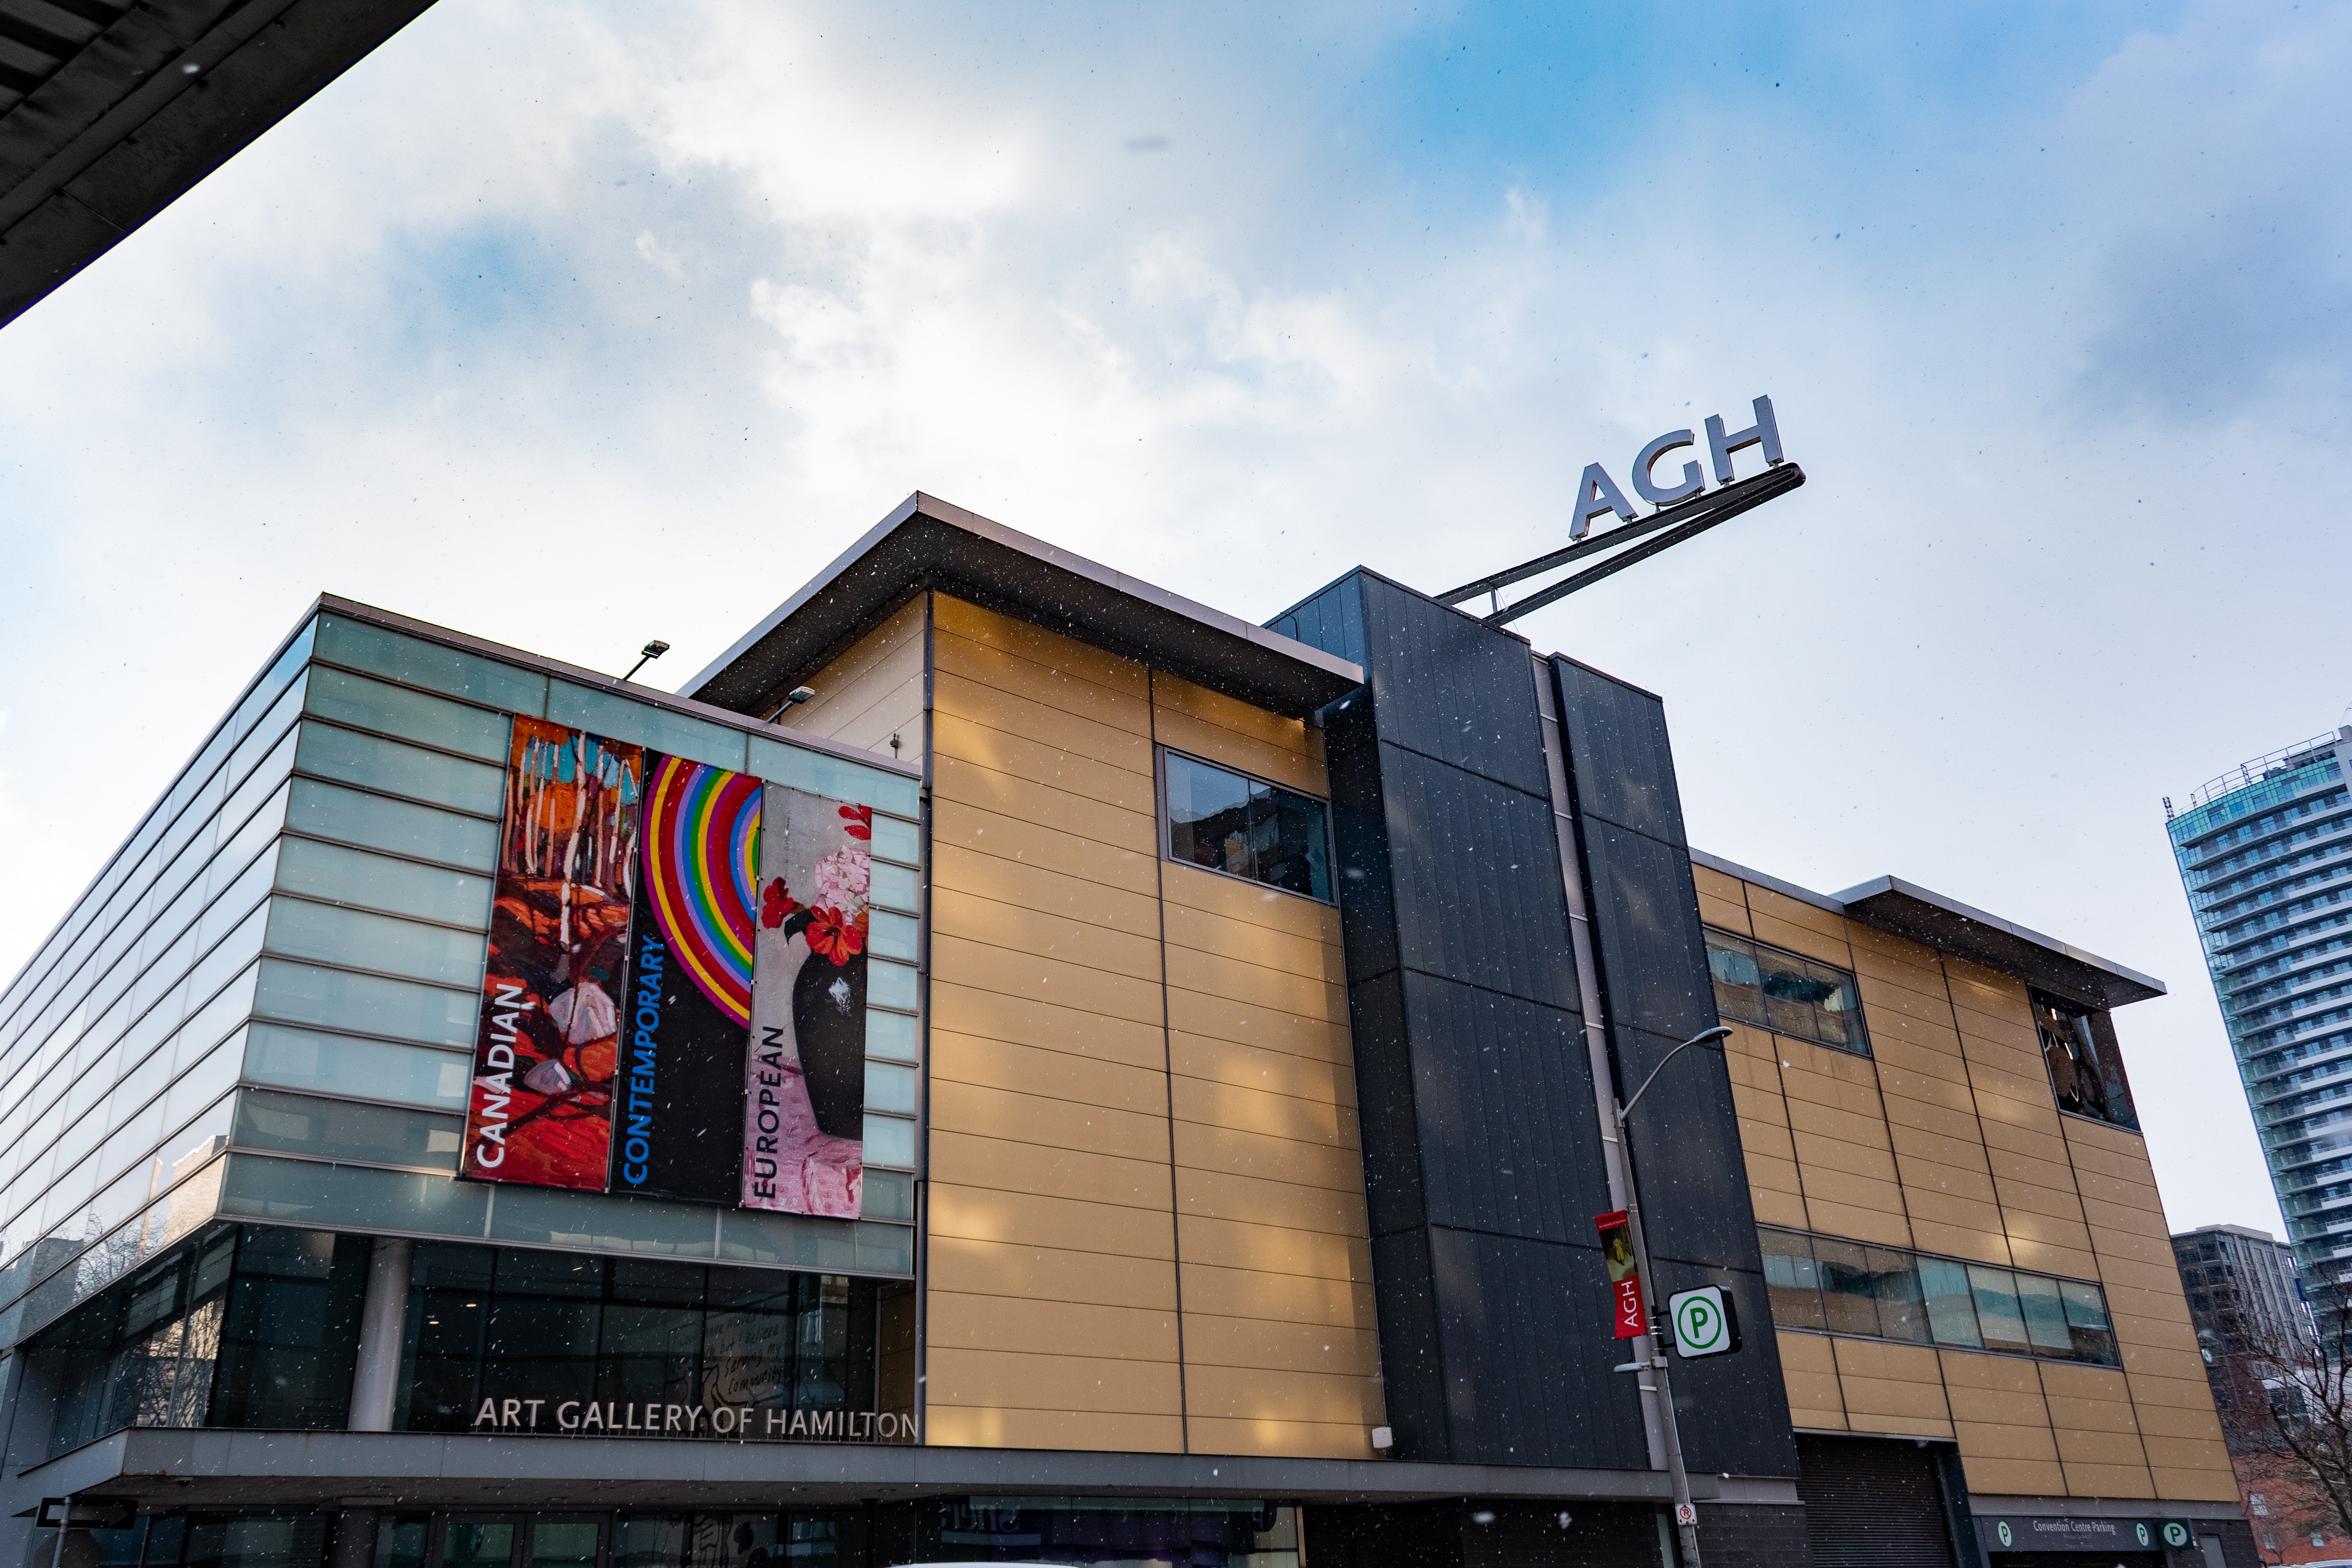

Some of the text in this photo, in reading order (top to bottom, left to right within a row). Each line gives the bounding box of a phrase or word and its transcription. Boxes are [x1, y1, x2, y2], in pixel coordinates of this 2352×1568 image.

[1569, 394, 1784, 541] AGH
[477, 983, 523, 1168] CANADIAN
[623, 934, 665, 1185] CONTEMPORARY
[753, 1025, 783, 1199] EUROPEAN
[1621, 1281, 1638, 1327] AGH
[720, 1337, 735, 1354] but
[745, 1324, 779, 1344] believe
[1690, 1307, 1708, 1339] P
[474, 1397, 918, 1438] ART GALLERY OF HAMILTON
[2001, 1526, 2008, 1543] P
[2033, 1520, 2116, 1535] Convention Centre Parking
[2139, 1527, 2145, 1543] P
[2169, 1526, 2181, 1542] P
